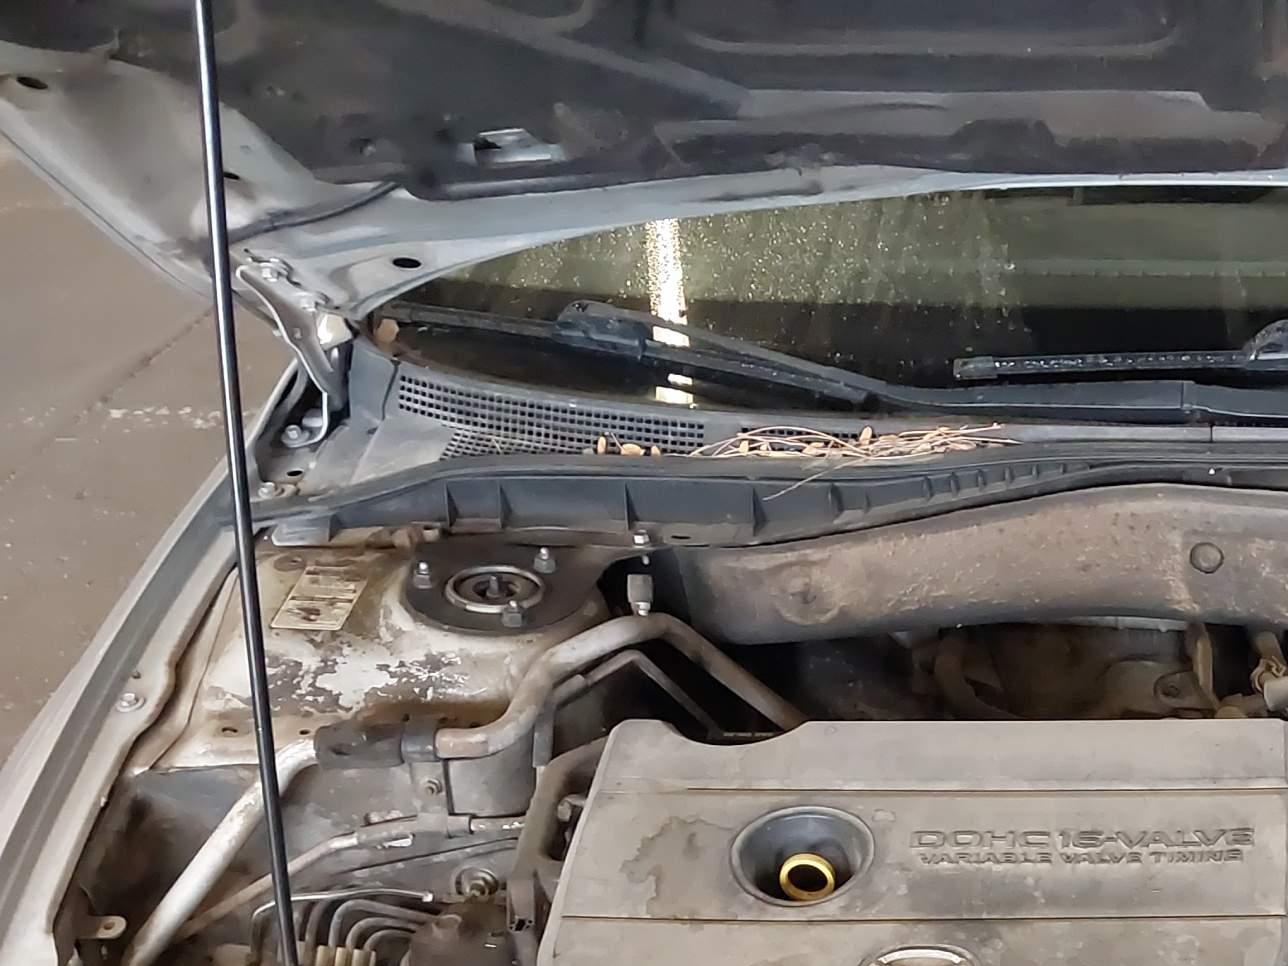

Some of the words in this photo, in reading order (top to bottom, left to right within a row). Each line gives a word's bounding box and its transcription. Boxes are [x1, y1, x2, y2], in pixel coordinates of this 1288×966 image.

[920, 852, 1053, 865] VARIABLE
[1061, 851, 1143, 864] VALVE
[1149, 849, 1245, 864] TIMING
